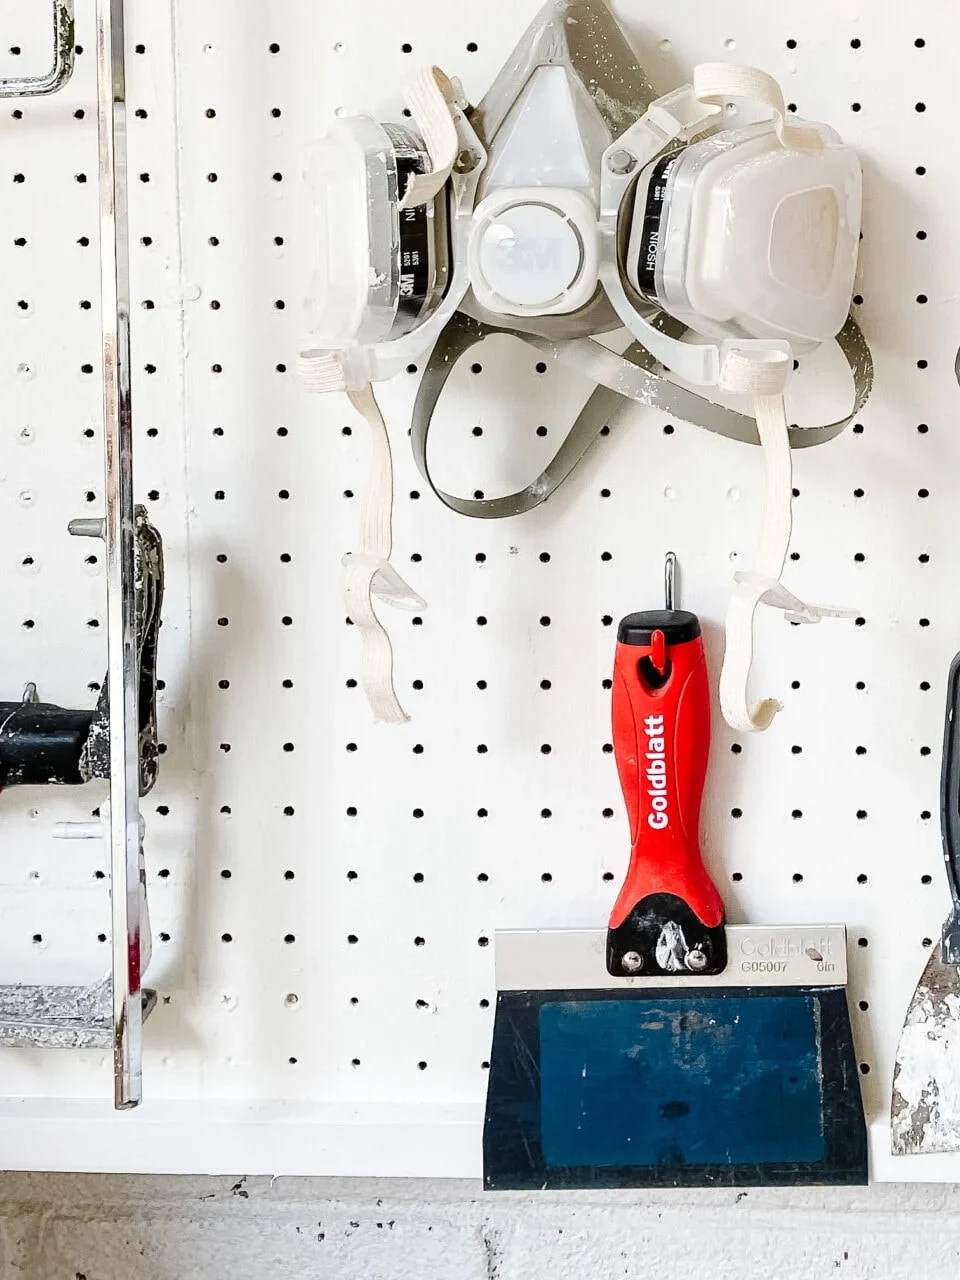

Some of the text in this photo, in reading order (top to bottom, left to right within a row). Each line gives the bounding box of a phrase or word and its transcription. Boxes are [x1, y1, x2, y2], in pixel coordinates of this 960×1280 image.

[645, 231, 660, 272] NIOSH
[400, 273, 415, 296] 3M
[643, 714, 669, 830] Goldblatt
[740, 936, 832, 957] Goldblatt
[741, 961, 788, 972] G05007
